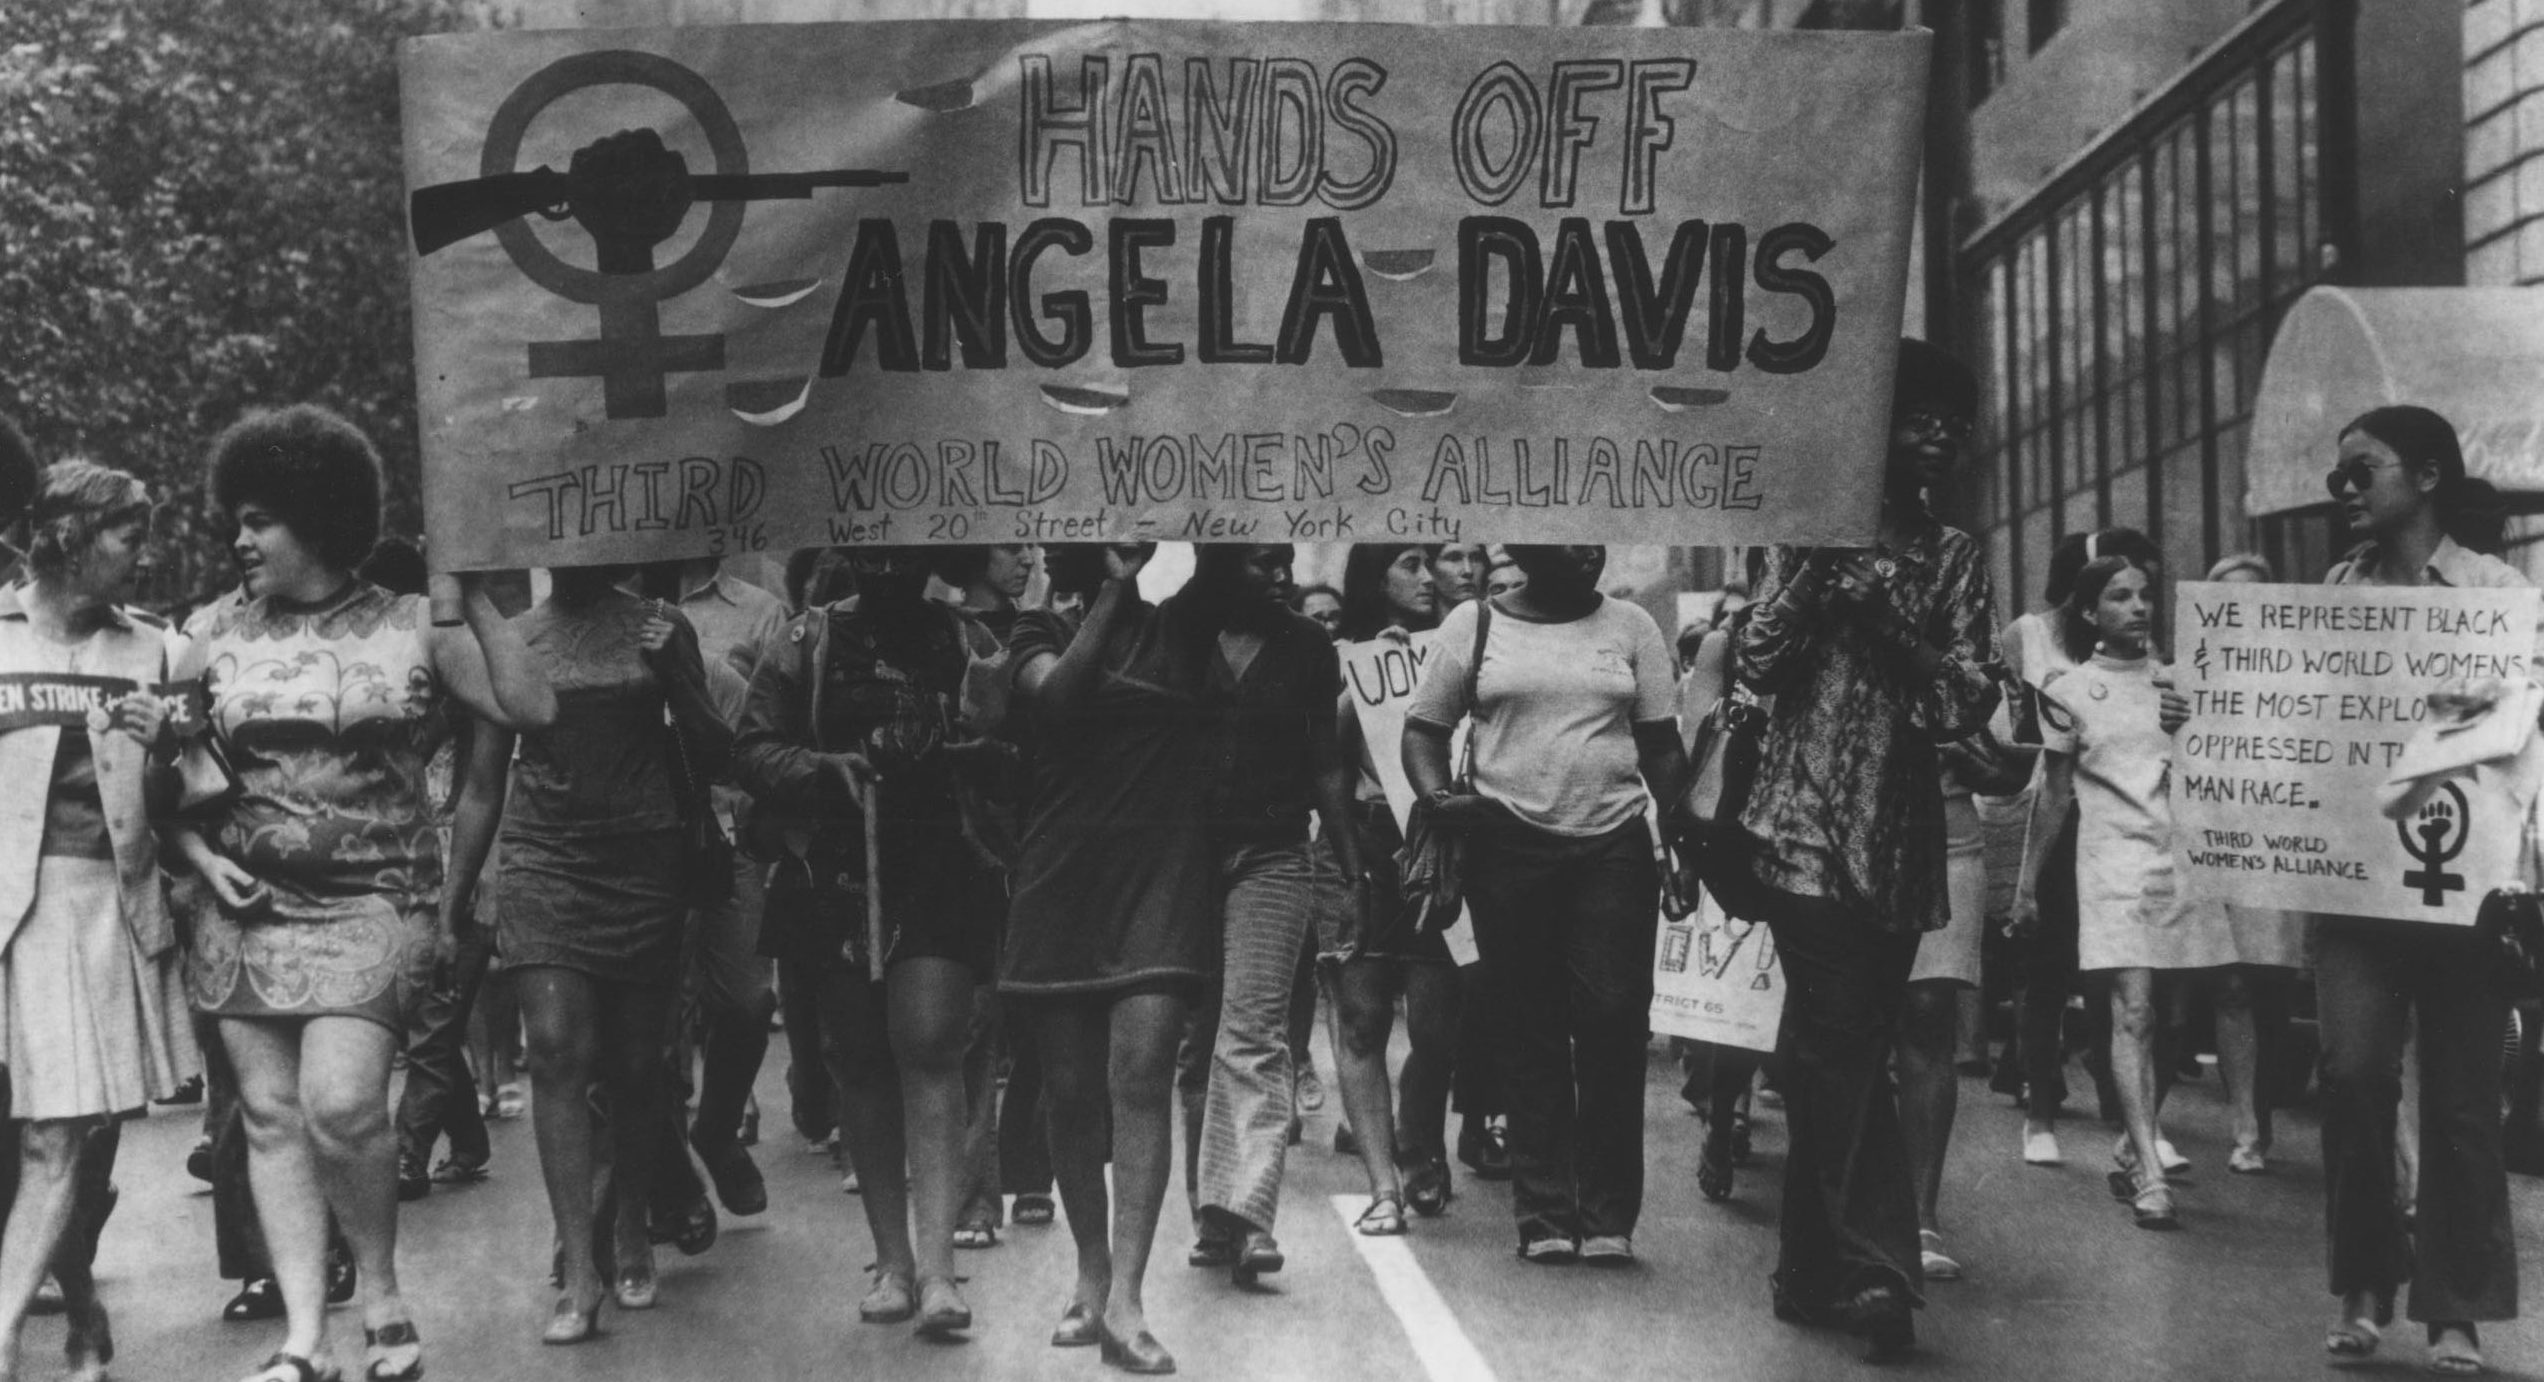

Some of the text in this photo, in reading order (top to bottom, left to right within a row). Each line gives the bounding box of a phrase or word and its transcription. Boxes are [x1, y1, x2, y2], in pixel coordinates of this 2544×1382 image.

[1019, 53, 1697, 215] HANDS OFF
[819, 215, 1837, 378] ANGELA DAVIS
[508, 422, 1762, 540] THIRD WORLD WOMEN'S ALLIANCE
[708, 522, 768, 554] 346
[827, 511, 892, 544] West
[1015, 507, 1107, 538] Street
[1183, 510, 1258, 537] New
[1284, 506, 1354, 538] York
[1386, 506, 1462, 543] City
[2194, 602, 2510, 636] WE REPRESENT BLACK
[2221, 647, 2293, 673] THIRD
[2303, 650, 2393, 677] WORLD
[2406, 651, 2525, 679] WOMENS
[30, 684, 101, 712] STRIKE
[2194, 690, 2244, 717] THE
[2256, 692, 2329, 720] MOST
[2186, 734, 2334, 765] OPPRESSED
[2349, 741, 2370, 766] IN
[2203, 829, 2328, 854] THIRD WORLD
[2187, 850, 2370, 881] WOMEN'S ALLIANCE
